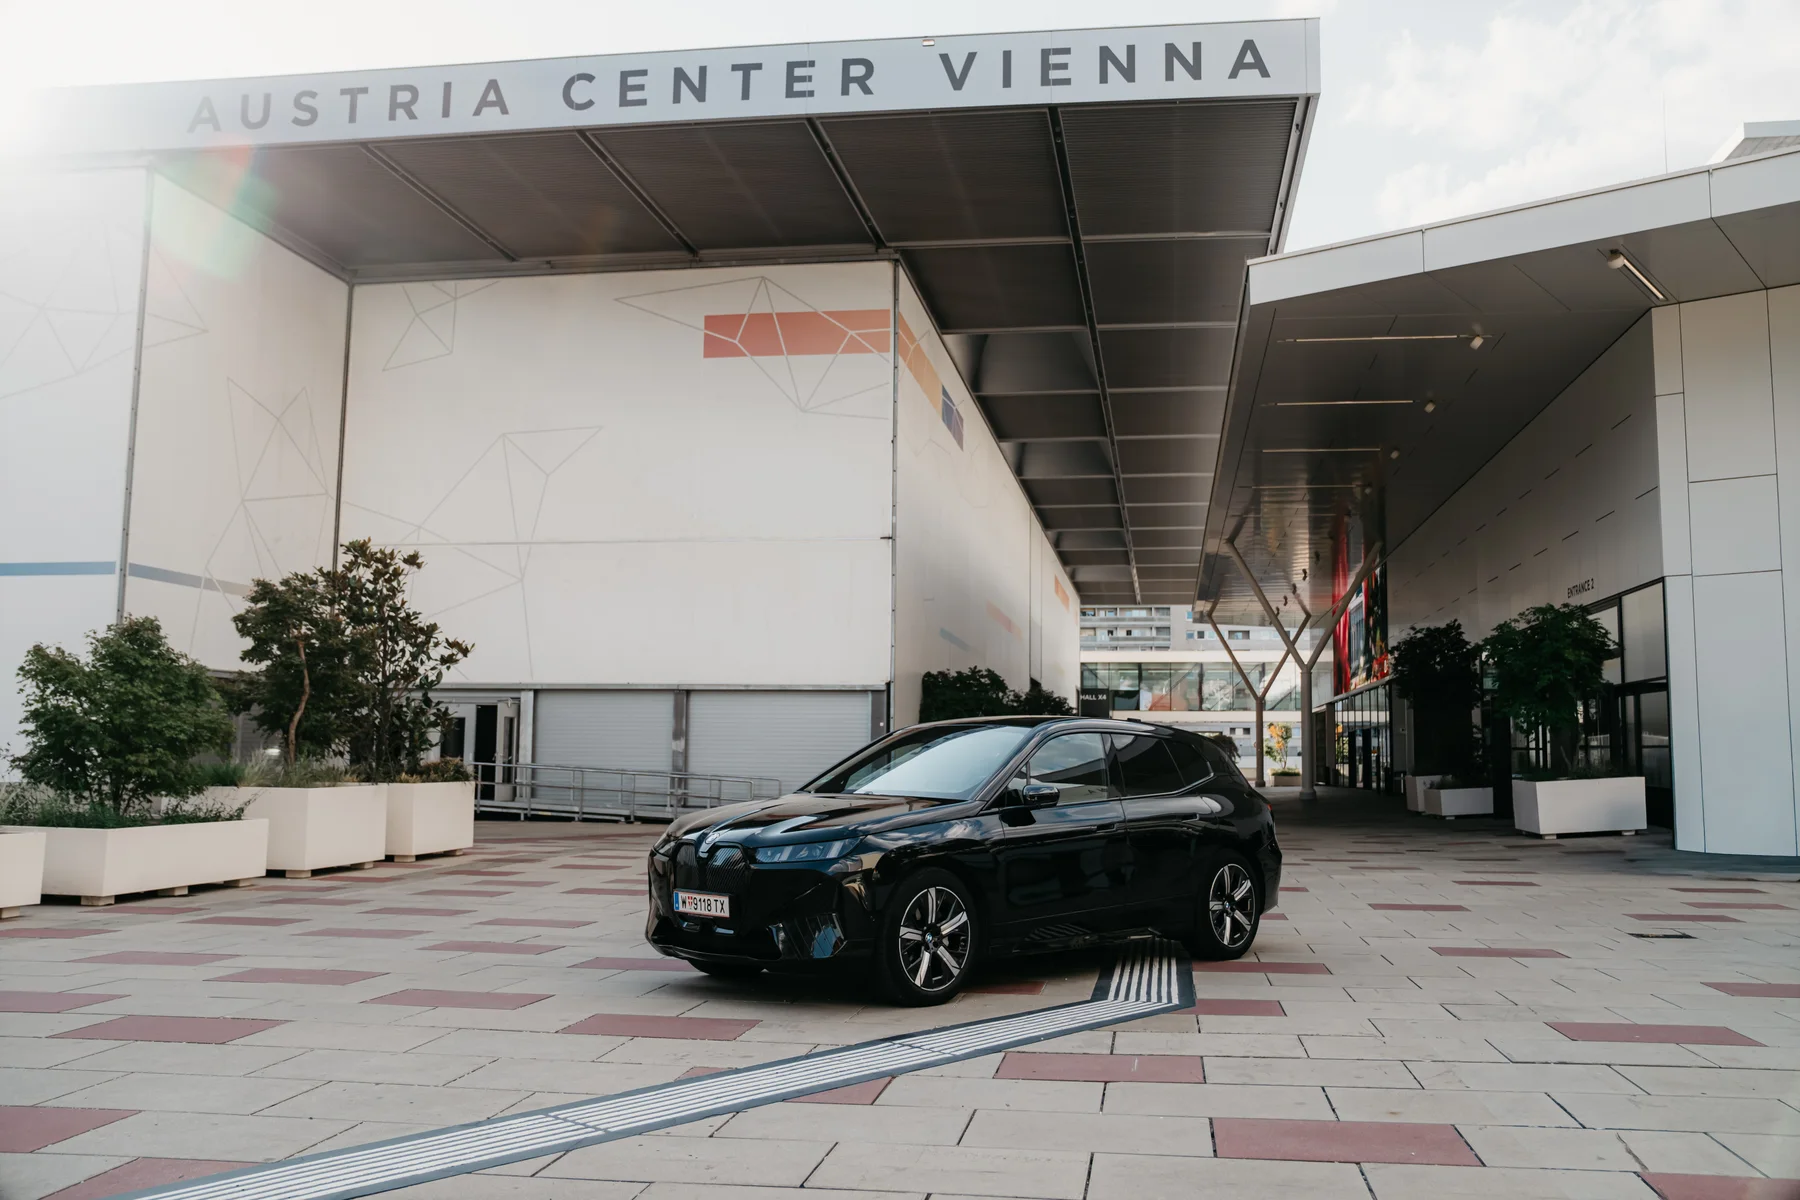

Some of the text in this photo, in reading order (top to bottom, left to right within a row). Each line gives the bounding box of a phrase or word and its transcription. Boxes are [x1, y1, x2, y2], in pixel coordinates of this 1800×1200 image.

[187, 39, 1271, 134] AUSTRIA CENTER VIENNA
[1567, 577, 1595, 599] ENTRANCE 2
[693, 897, 712, 912] 9118
[713, 899, 726, 914] TX
